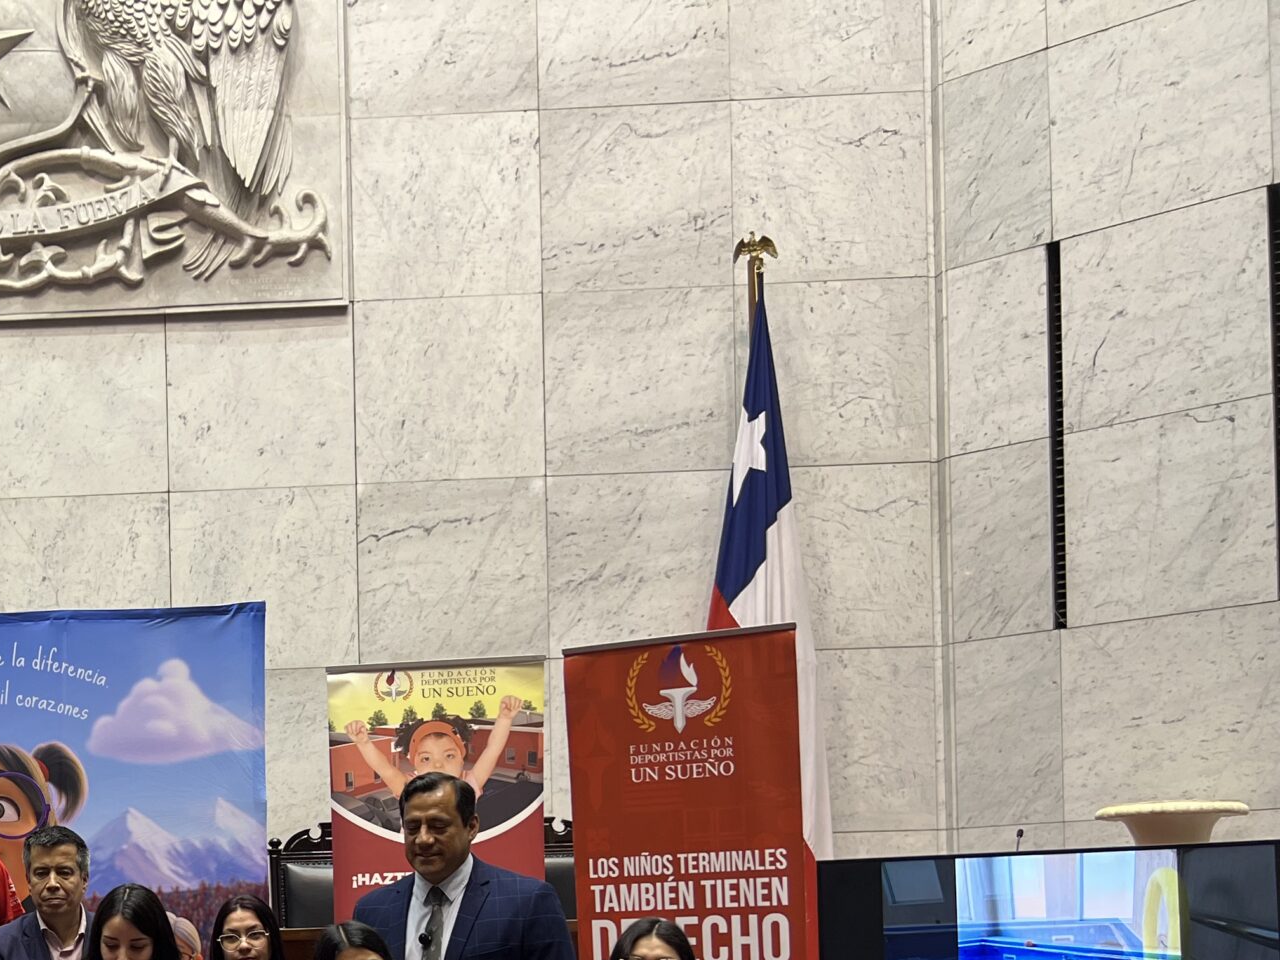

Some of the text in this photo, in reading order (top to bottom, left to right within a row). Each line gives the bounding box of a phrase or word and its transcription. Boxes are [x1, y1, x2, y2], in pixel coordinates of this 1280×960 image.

[10, 212, 46, 235] LA
[56, 181, 156, 230] FUERZA
[11, 641, 25, 668] la
[31, 645, 109, 689] diferencia.
[421, 668, 497, 678] FUNDACIÓN
[421, 675, 496, 686] DEPORTISTAS POR
[421, 684, 497, 699] UN SUEÑO
[15, 693, 89, 721] corazones
[629, 736, 734, 754] FUNDACIÓN
[629, 747, 734, 765] DEPORTISTAS POR
[631, 759, 735, 783] UN SUEÑO
[588, 848, 788, 878] LOS NIÑOS TERMINALES
[590, 876, 789, 913] TAMBIÉN TIENEN
